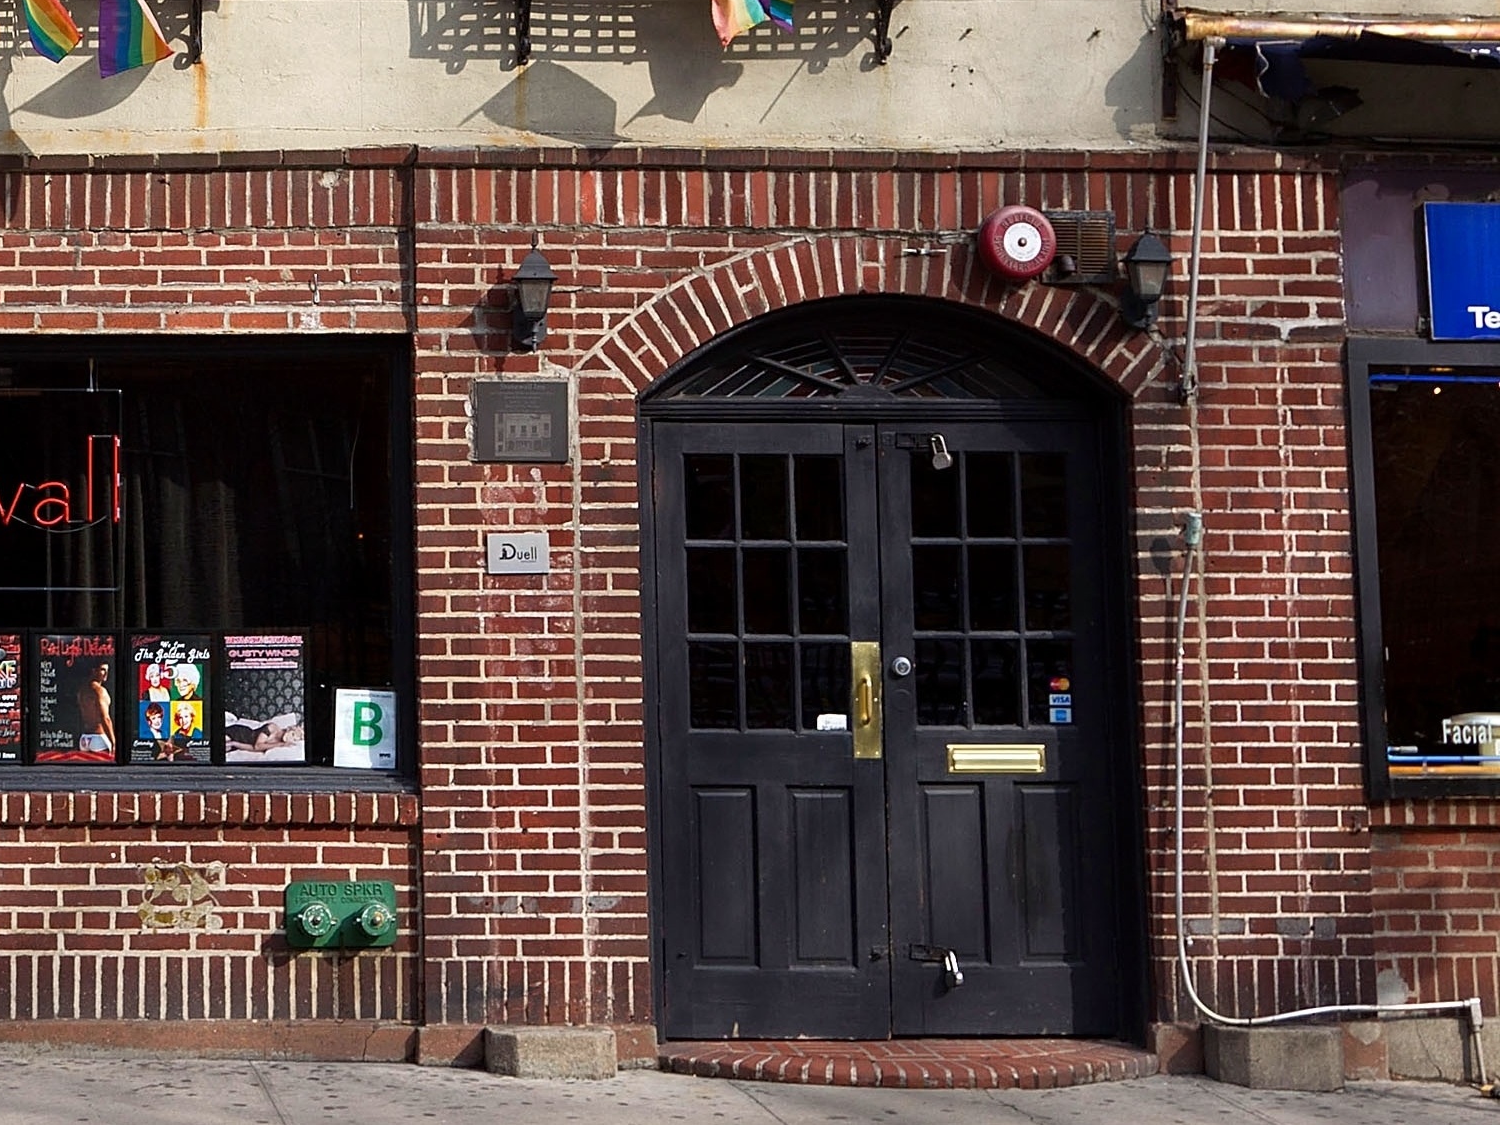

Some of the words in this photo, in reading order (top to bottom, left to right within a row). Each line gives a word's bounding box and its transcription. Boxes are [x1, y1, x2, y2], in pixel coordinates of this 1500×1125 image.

[1467, 306, 1500, 329] Te
[499, 543, 537, 560] Duell
[40, 637, 60, 655] Red
[134, 648, 154, 661] The
[155, 648, 186, 663] Golden
[187, 648, 210, 663] Girls
[353, 701, 383, 746] B
[1442, 718, 1492, 744] Facial
[300, 882, 337, 896] AUTO
[343, 882, 383, 896] SPKR
